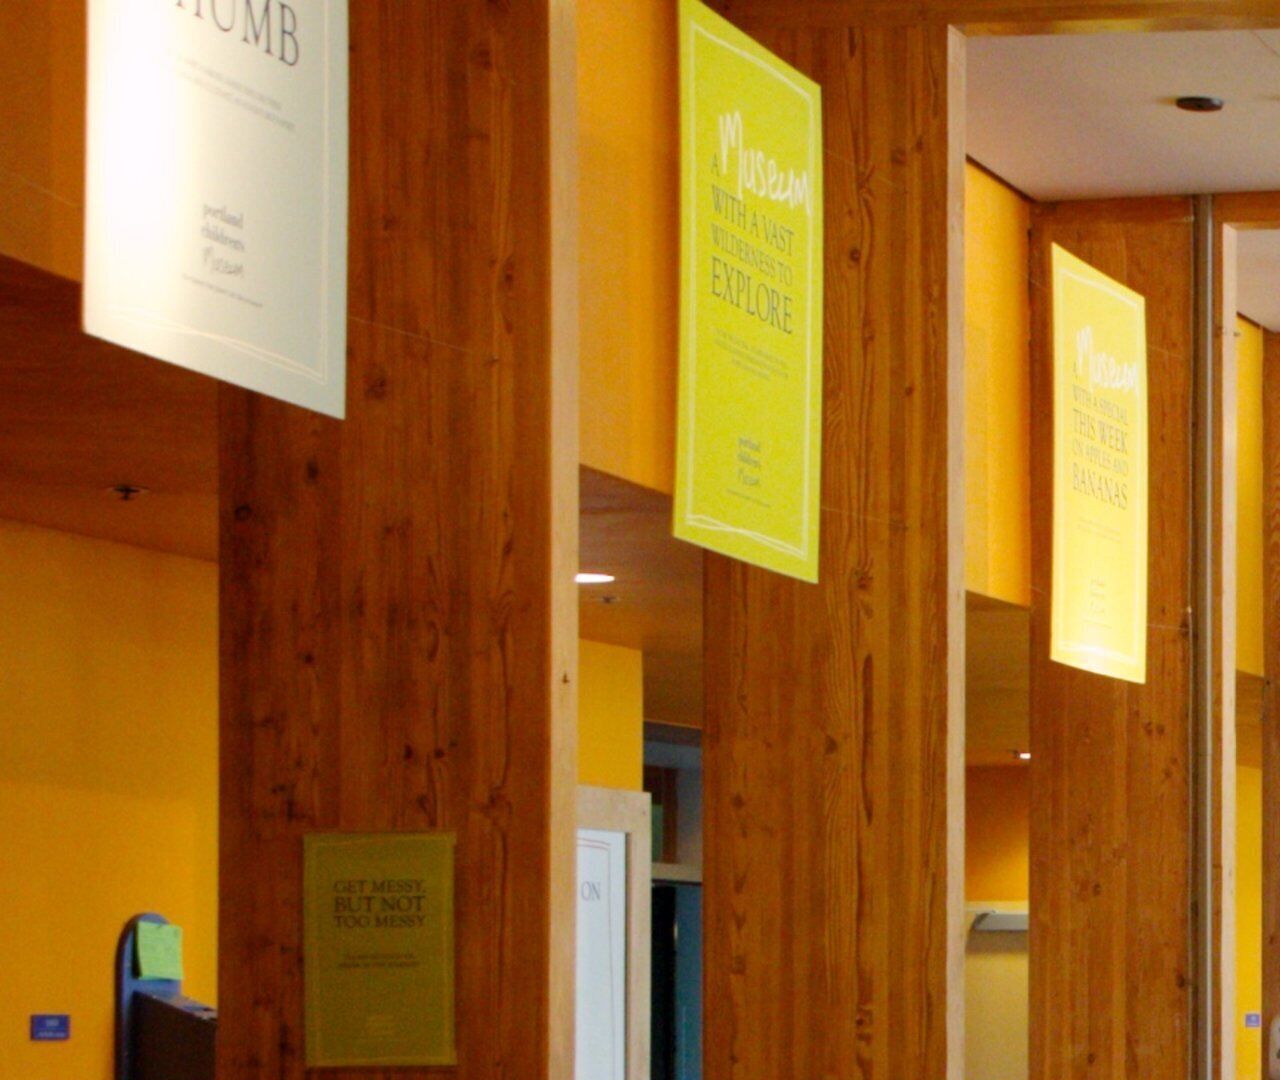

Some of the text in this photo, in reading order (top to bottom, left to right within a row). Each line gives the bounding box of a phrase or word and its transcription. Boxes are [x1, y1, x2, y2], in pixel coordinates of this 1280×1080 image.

[718, 110, 814, 217] Museum
[711, 184, 795, 257] WITH A VAST
[711, 222, 793, 287] WILDERNESS TO
[711, 255, 793, 335] EXPLORE
[1076, 325, 1139, 397] Museum
[1072, 407, 1128, 455] THIS WEEK
[1072, 461, 1128, 511] BANANAS
[333, 879, 367, 894] GET
[334, 895, 426, 913] BUT NOT
[333, 915, 427, 928] TOO MESSY
